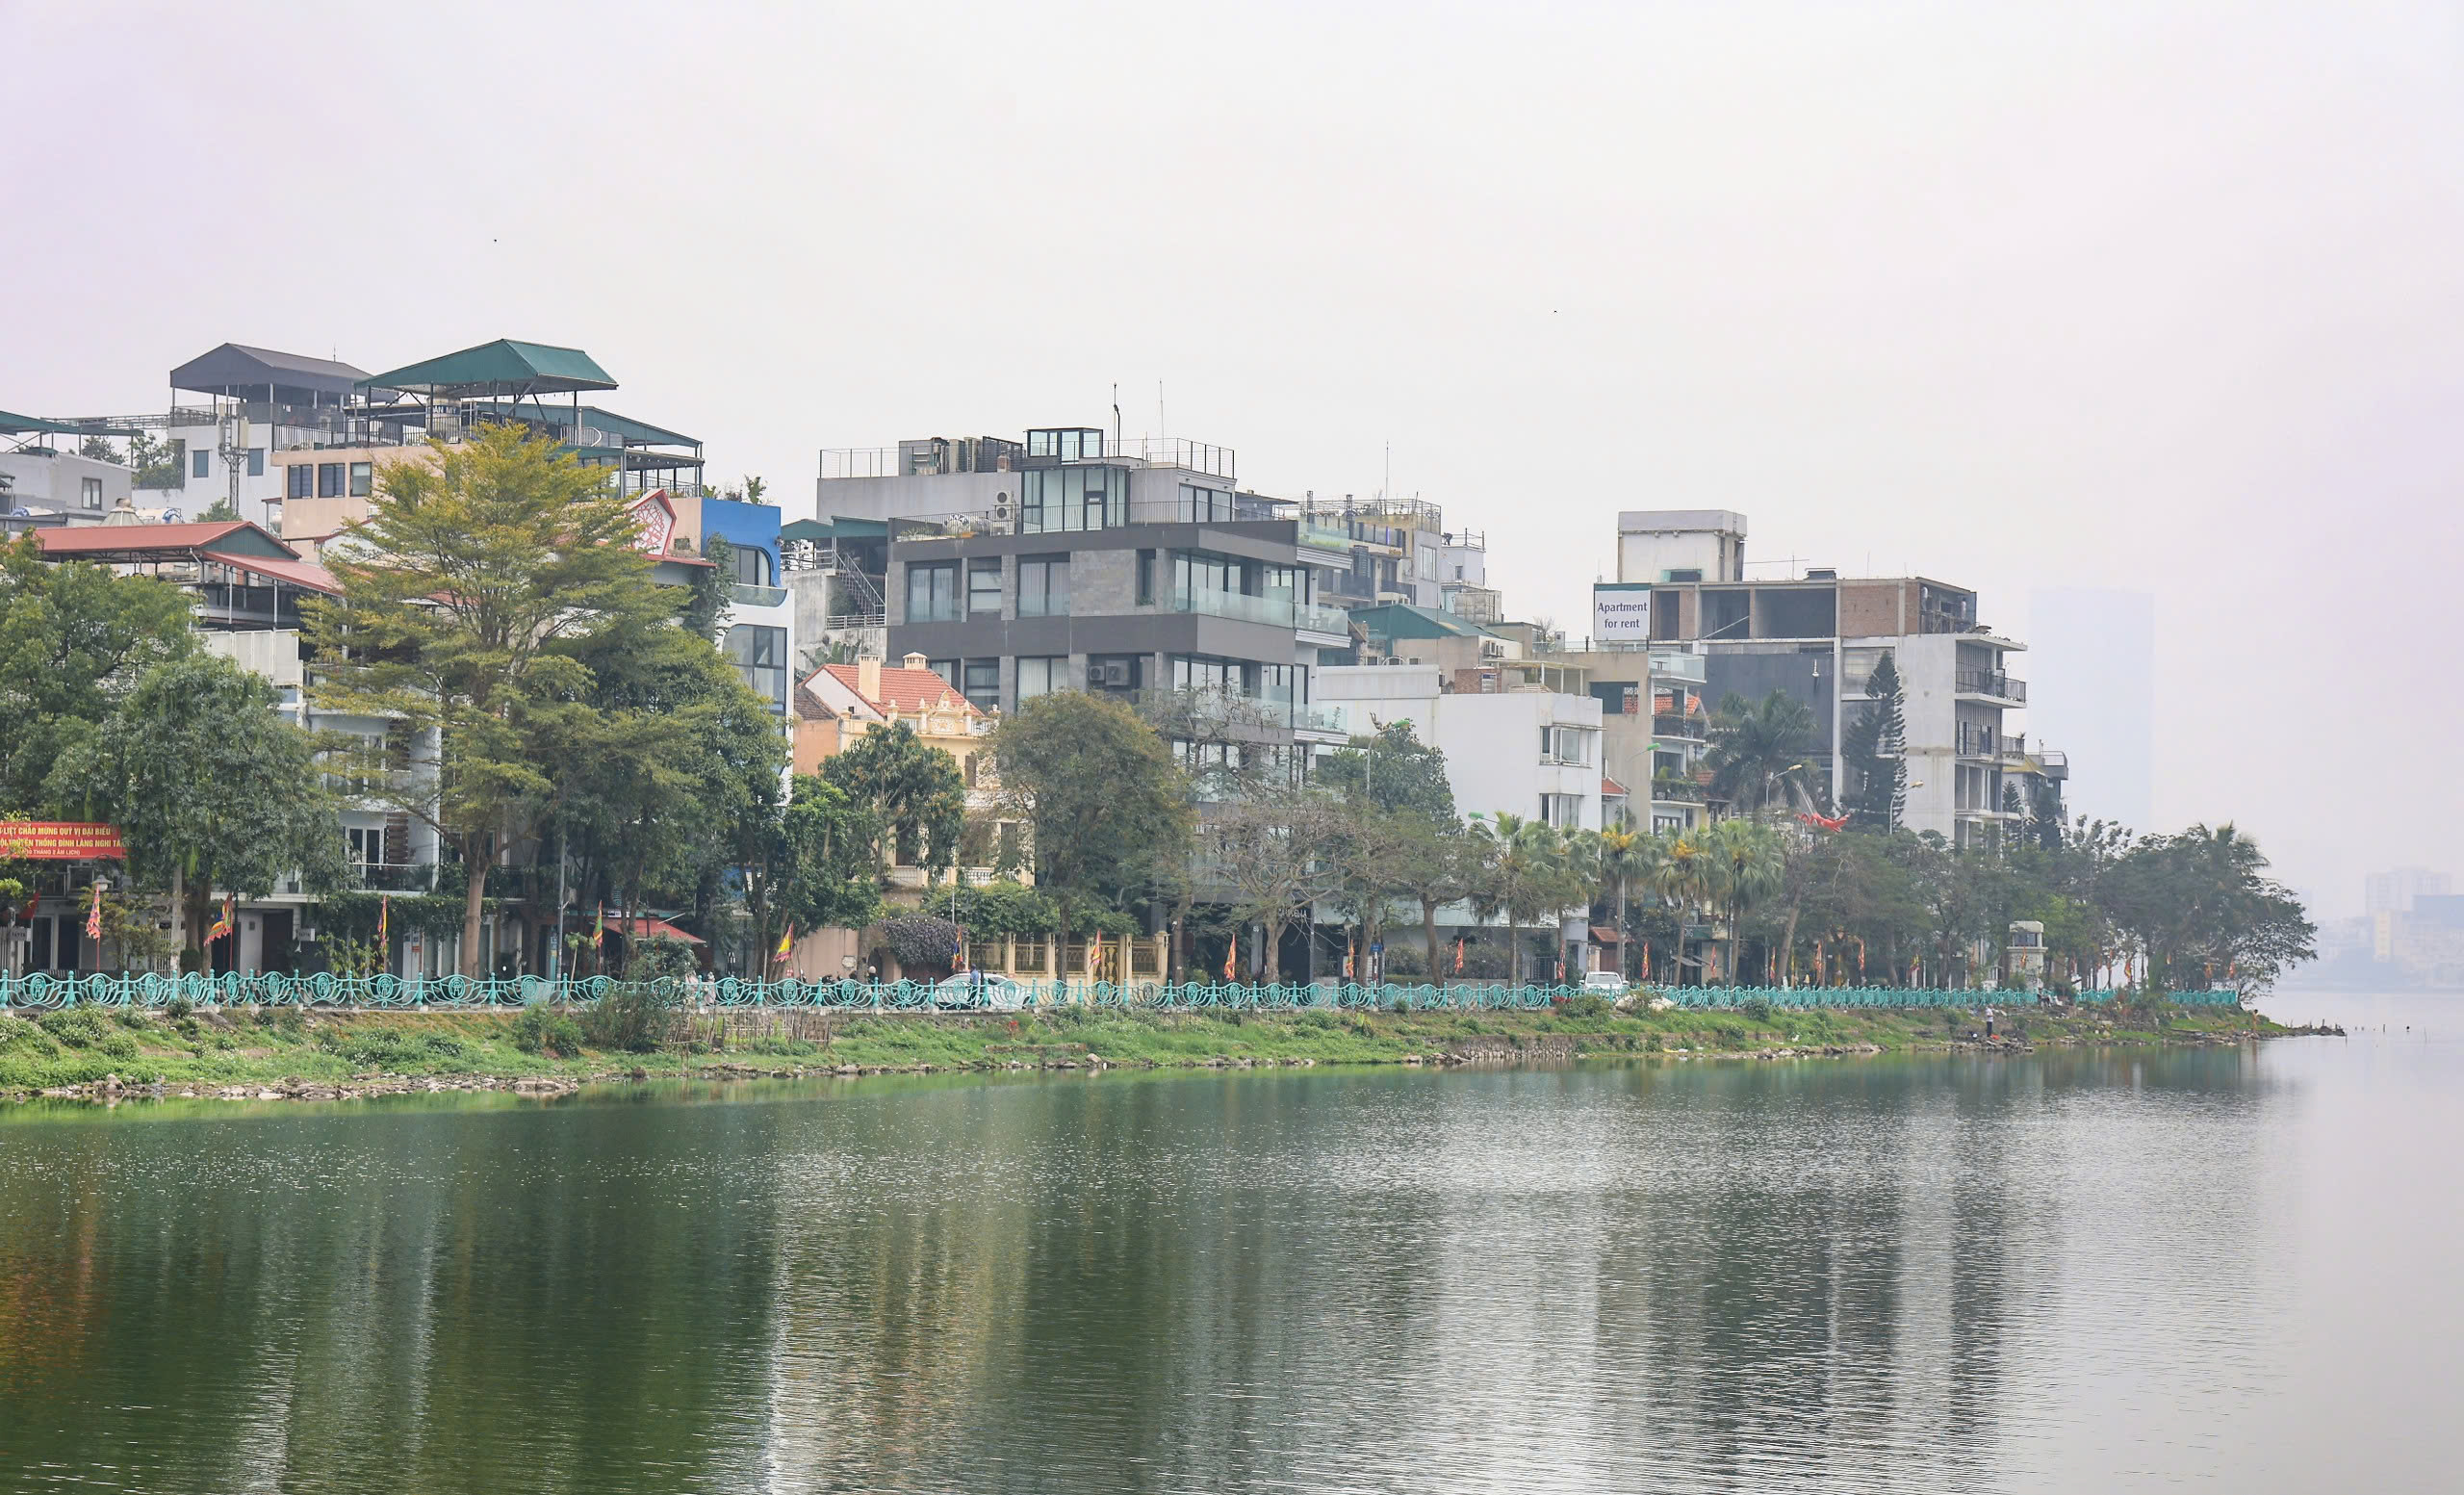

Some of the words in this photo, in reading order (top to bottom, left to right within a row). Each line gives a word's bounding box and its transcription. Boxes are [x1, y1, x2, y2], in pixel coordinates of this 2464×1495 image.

[1598, 603, 1648, 614] Apartment
[1604, 619, 1618, 629] for
[1621, 619, 1640, 629] rent
[76, 838, 93, 847] LÀNG
